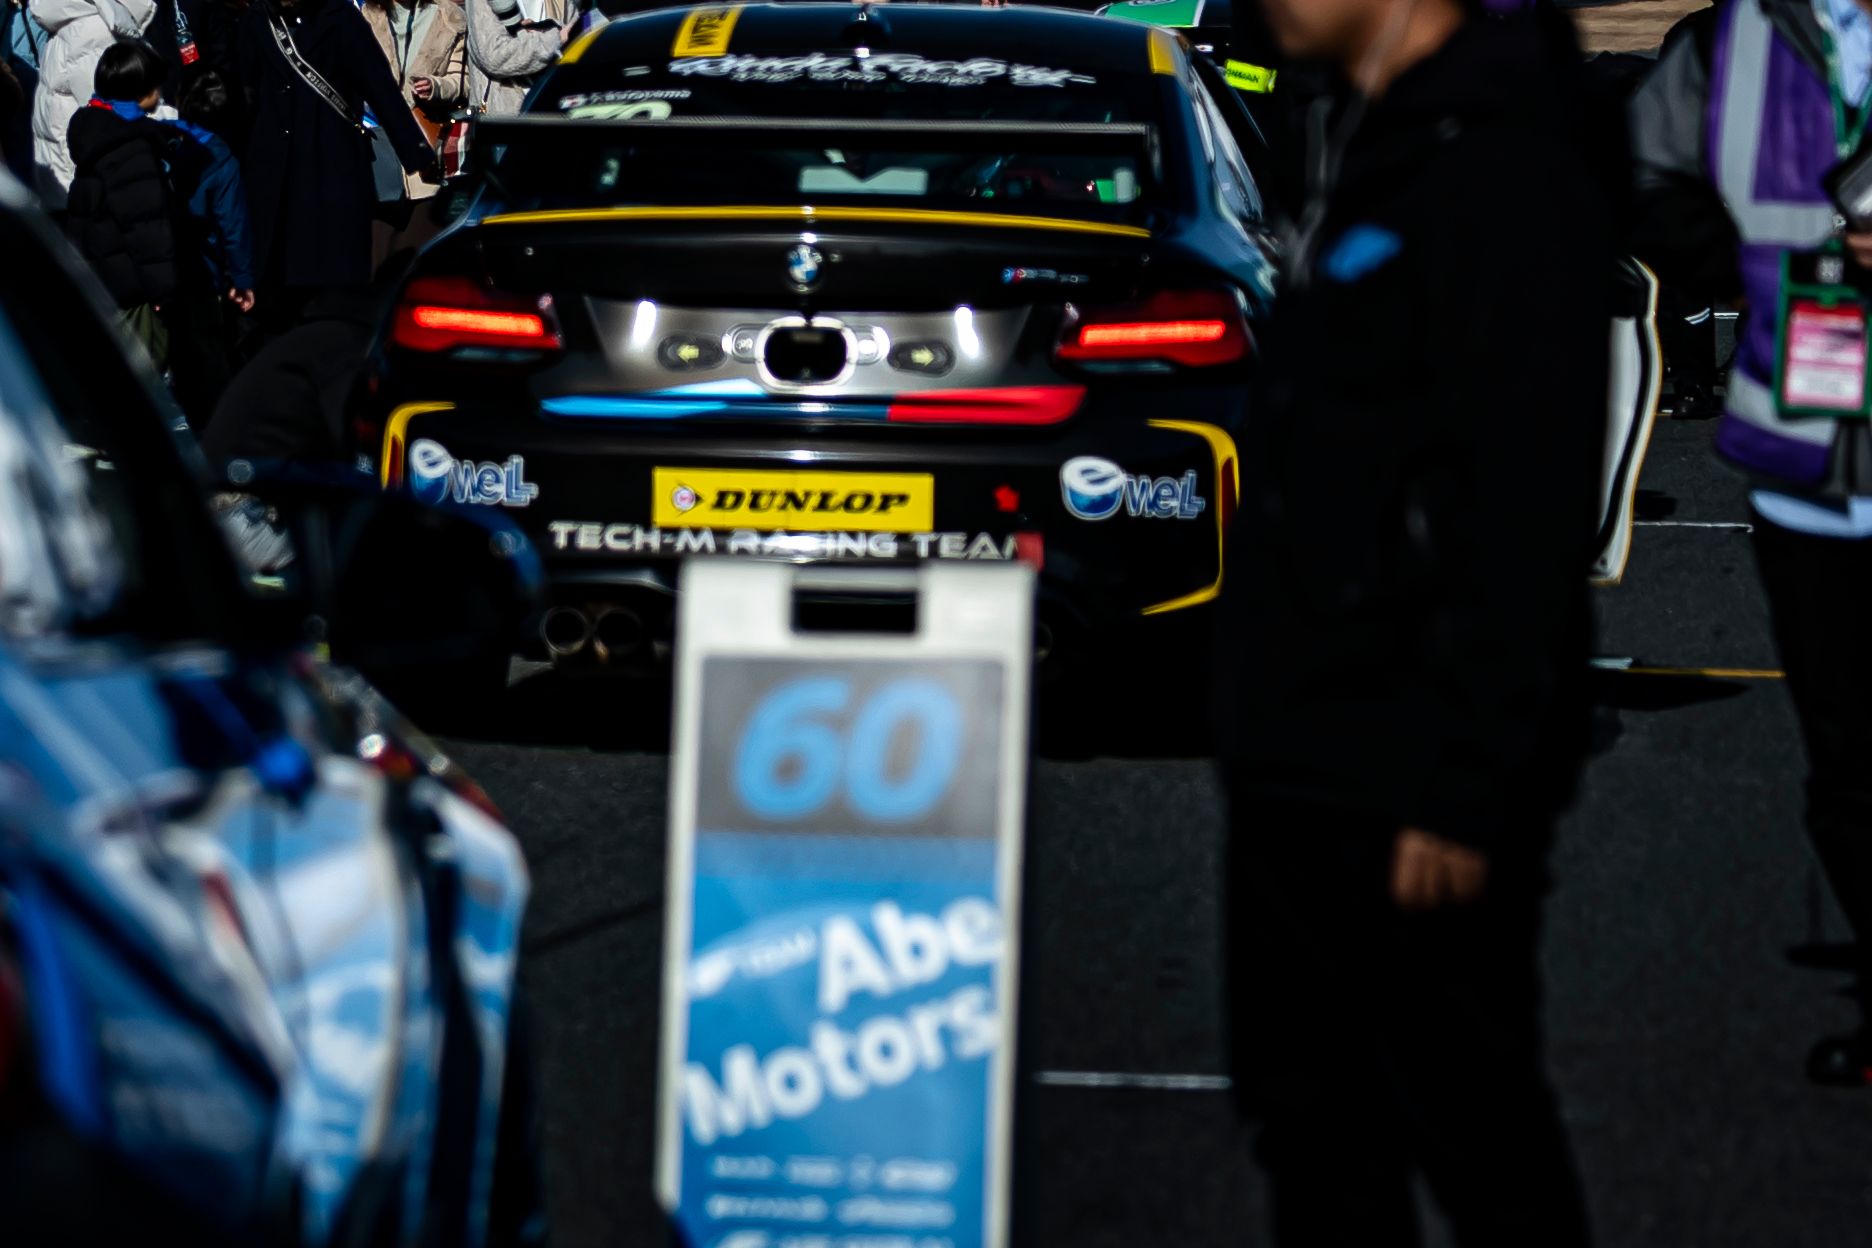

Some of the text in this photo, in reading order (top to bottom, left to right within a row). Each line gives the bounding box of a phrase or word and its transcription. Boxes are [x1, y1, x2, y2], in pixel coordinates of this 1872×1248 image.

[548, 521, 716, 554] TECH-M
[710, 489, 912, 515] DUNLOP
[732, 674, 964, 824] 60
[818, 898, 1002, 1014] Abe
[680, 984, 1000, 1146] Motors
